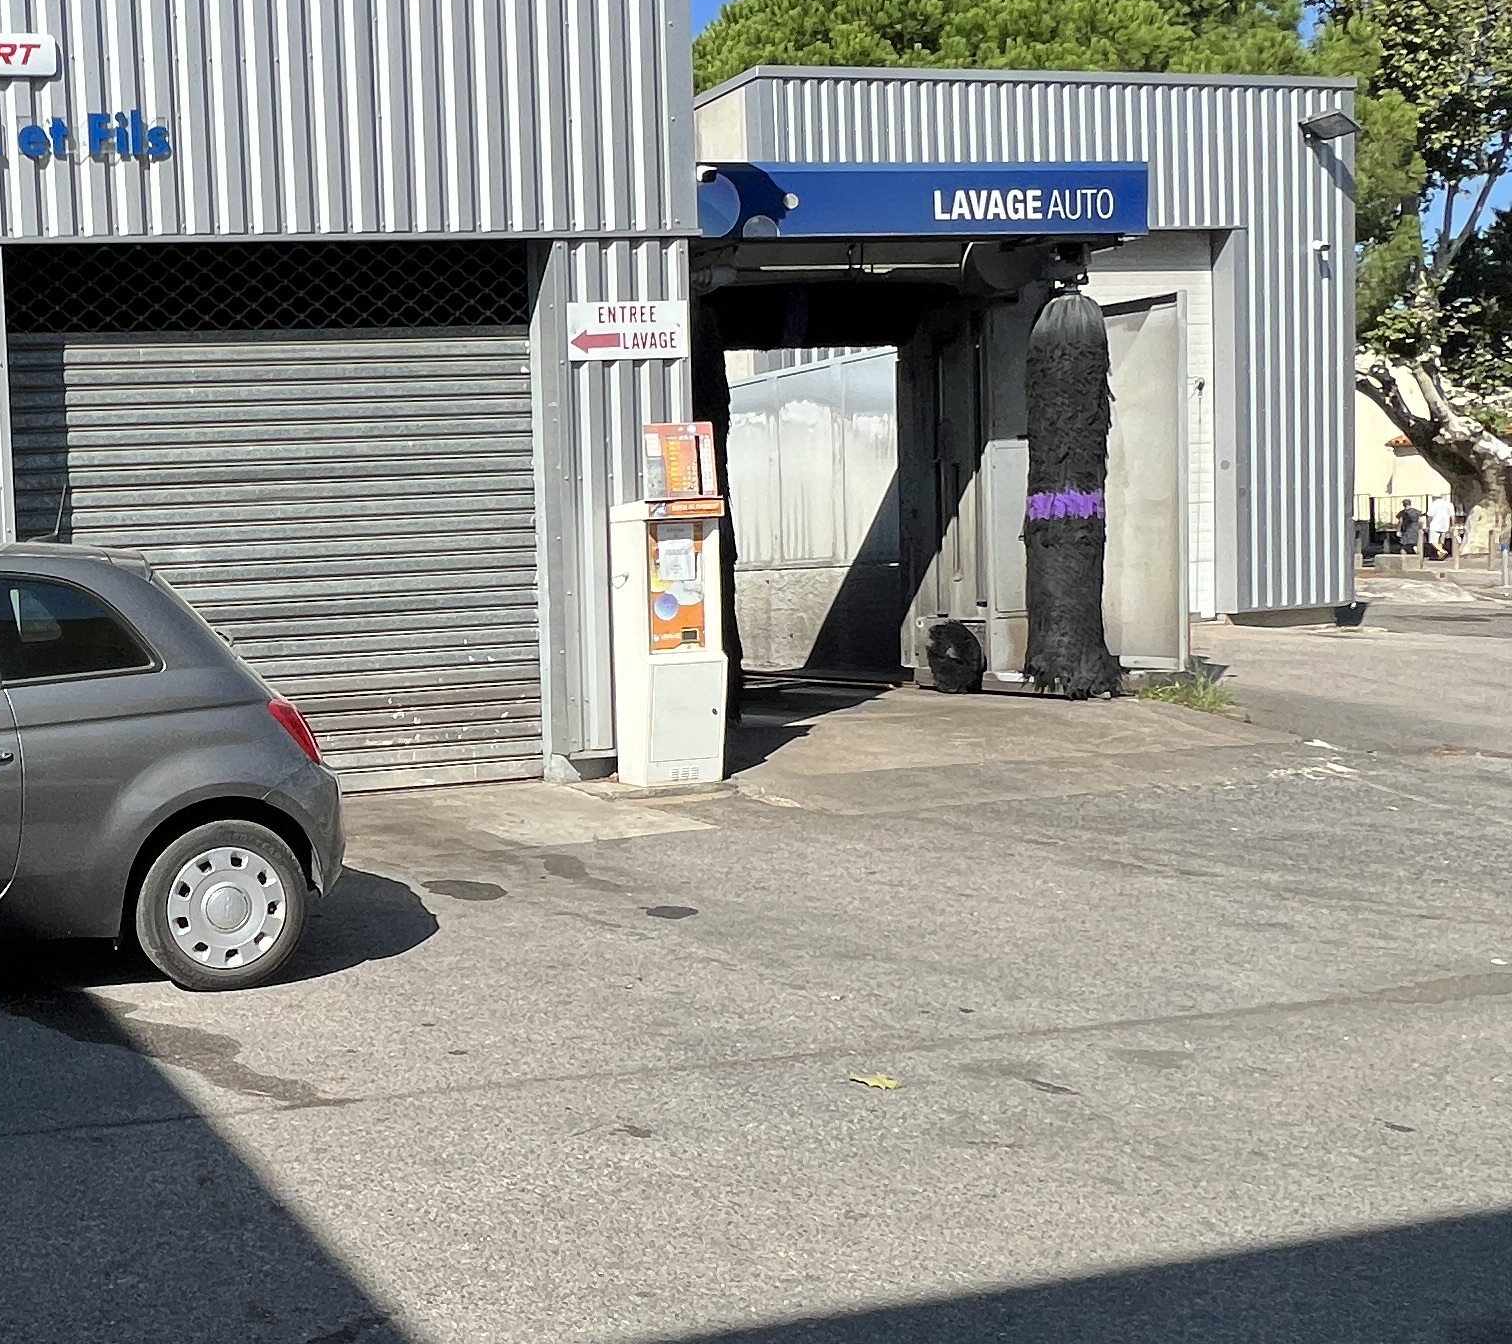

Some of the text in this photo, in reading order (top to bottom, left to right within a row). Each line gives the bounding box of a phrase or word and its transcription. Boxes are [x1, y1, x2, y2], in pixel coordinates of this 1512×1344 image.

[19, 119, 68, 156] et
[89, 110, 170, 156] Fils
[933, 189, 1114, 220] LAVAGE AUTO
[598, 305, 657, 323] ENTREE
[623, 331, 677, 349] LAVAGE
